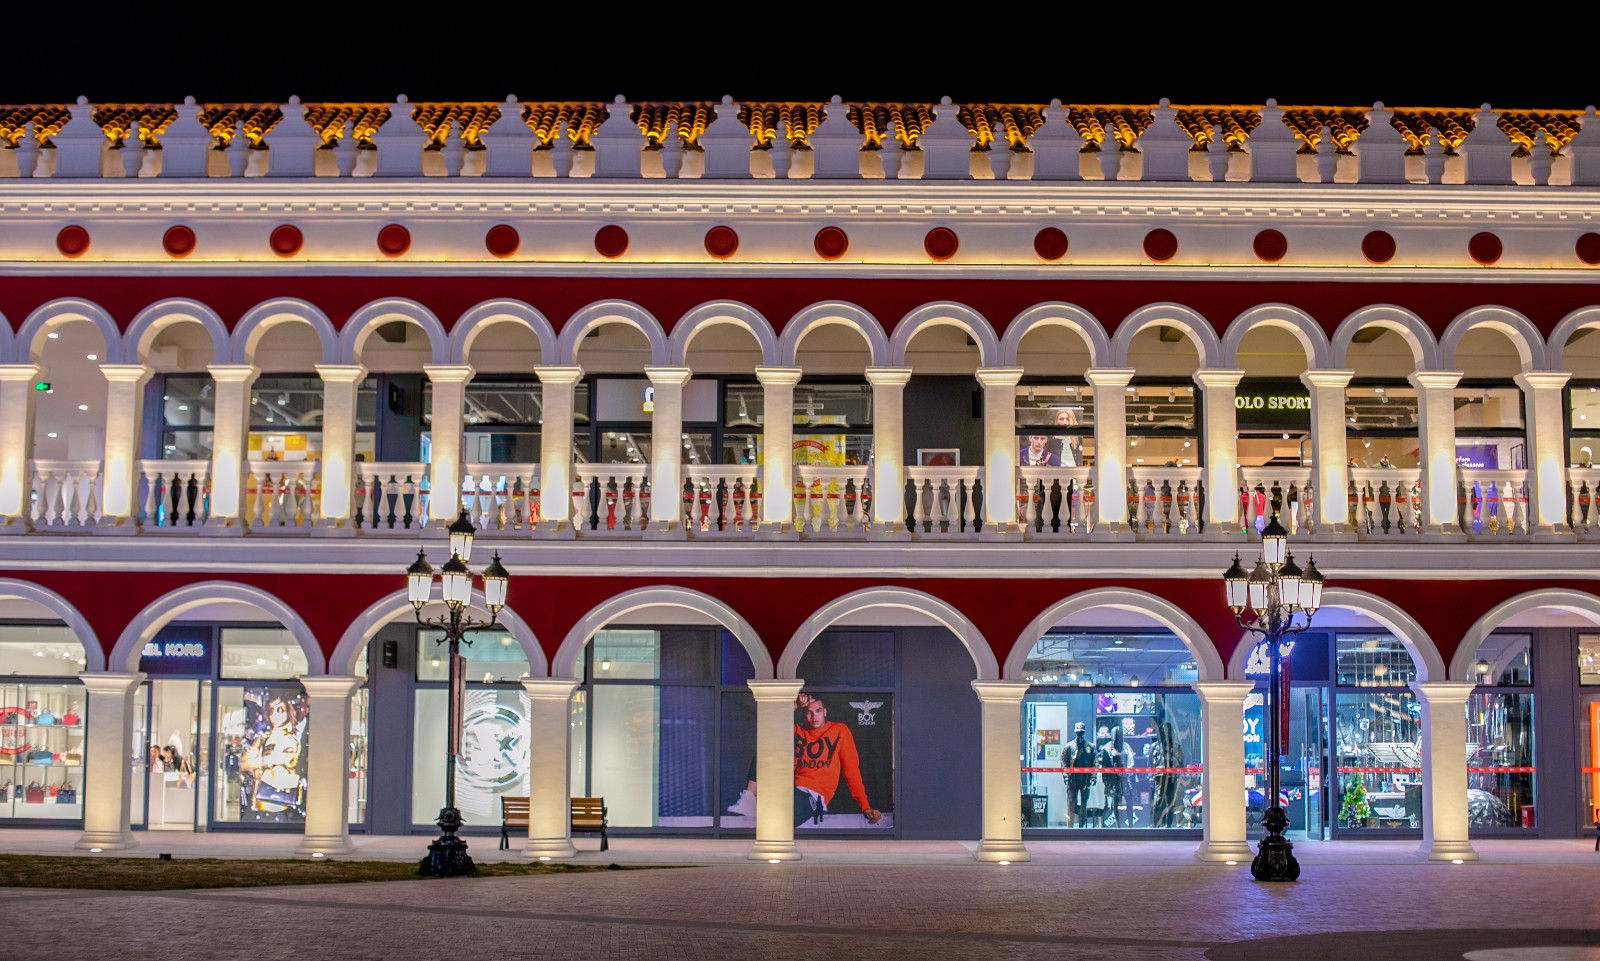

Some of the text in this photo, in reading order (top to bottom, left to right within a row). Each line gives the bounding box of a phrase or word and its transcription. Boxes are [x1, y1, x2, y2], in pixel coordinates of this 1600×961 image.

[165, 643, 204, 657] KORS
[858, 713, 876, 722] BOY
[794, 734, 840, 761] BOY
[794, 758, 831, 769] ONDON
